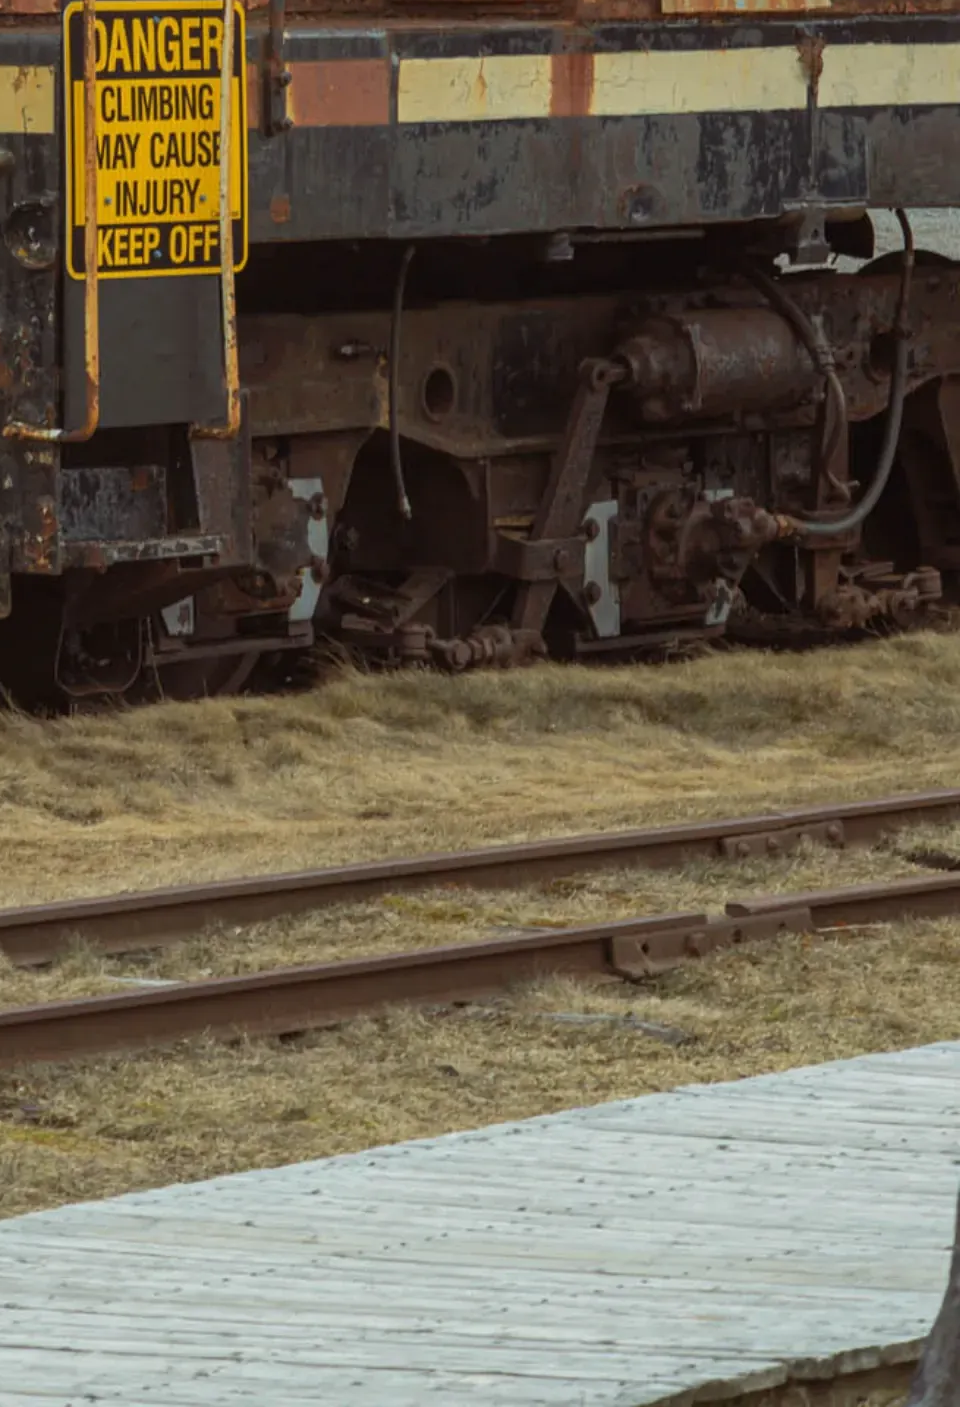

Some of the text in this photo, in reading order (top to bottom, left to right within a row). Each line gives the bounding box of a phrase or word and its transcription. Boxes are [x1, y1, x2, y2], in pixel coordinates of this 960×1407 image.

[100, 83, 214, 122] CLIMBING
[96, 131, 221, 170] MAY CAUSE
[115, 178, 200, 217] INJURY
[97, 224, 220, 267] KEEP OFF
